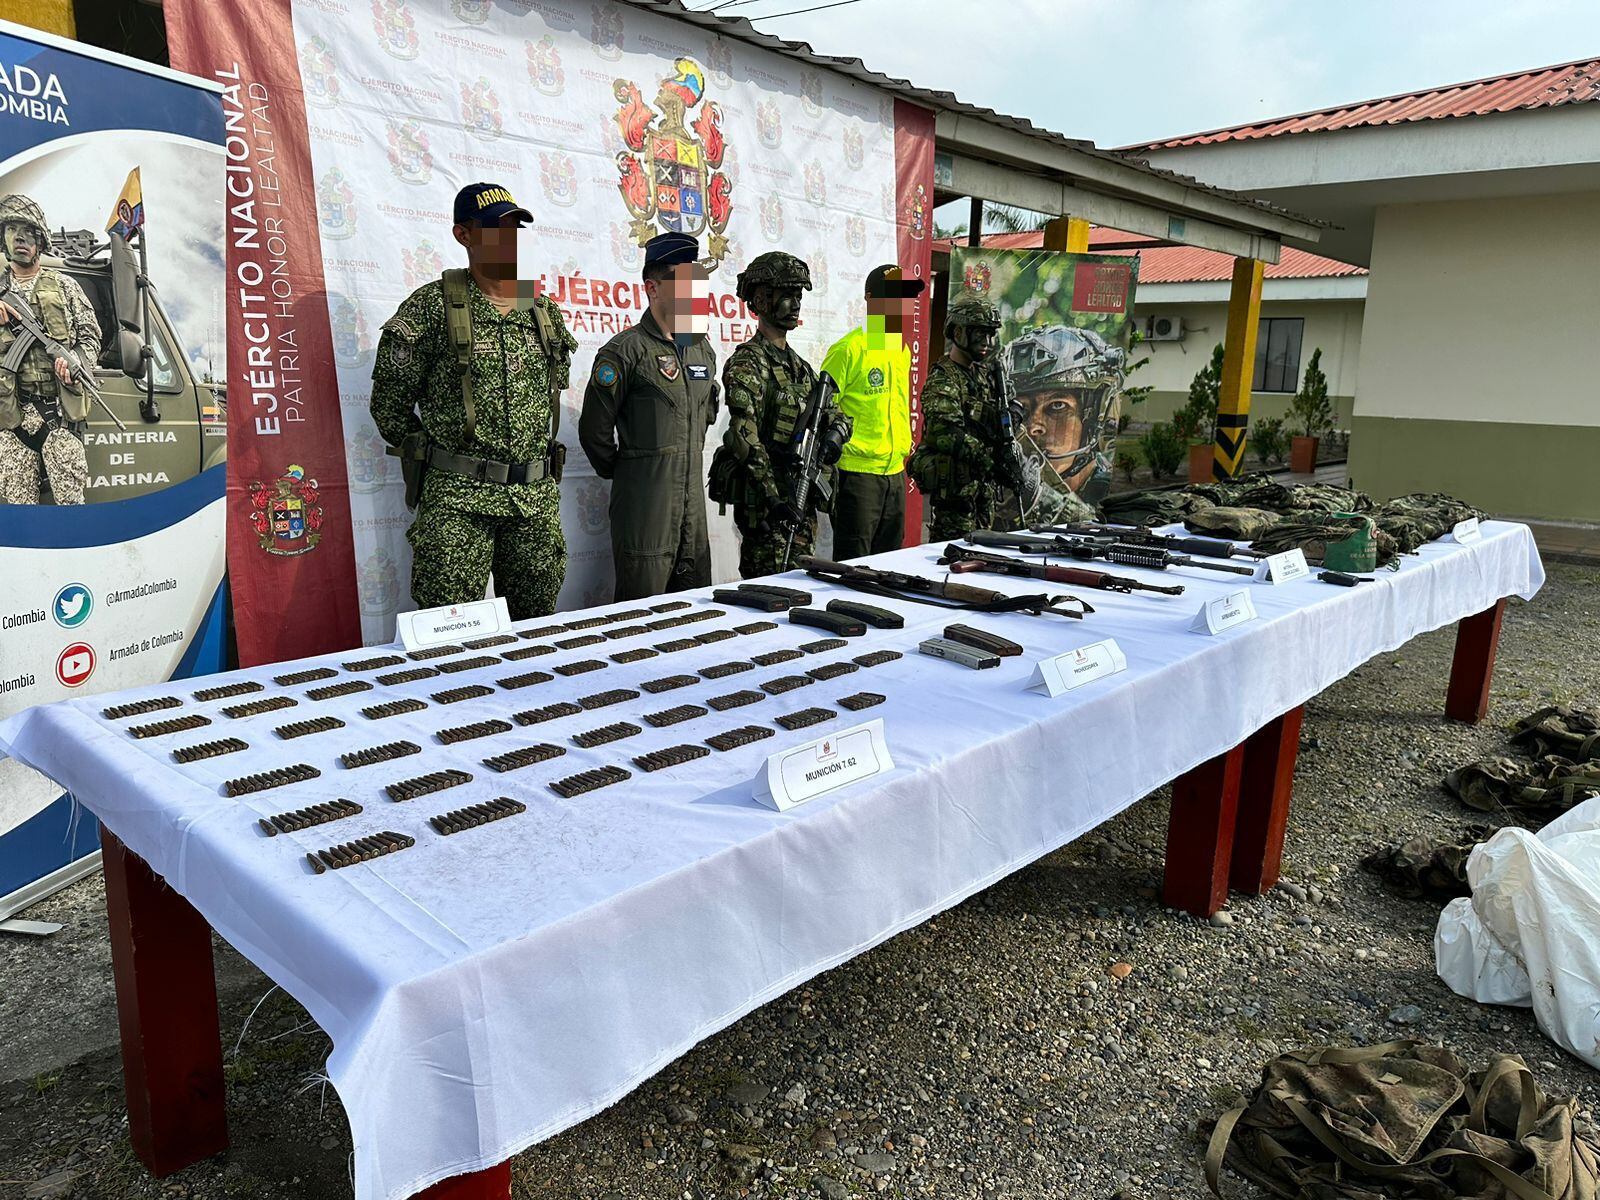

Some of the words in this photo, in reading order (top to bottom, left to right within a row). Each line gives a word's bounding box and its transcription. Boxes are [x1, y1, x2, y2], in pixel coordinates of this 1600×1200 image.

[215, 61, 260, 249] NACIONAL
[248, 82, 281, 207] LEALTAD
[265, 217, 295, 318] HONOR
[236, 261, 281, 435] EJÉRCITO
[277, 328, 306, 422] PATRIA
[84, 431, 177, 445] FANTERIA
[110, 453, 135, 465] DE
[106, 578, 177, 607] @ArmadaColombia
[2, 608, 46, 629] Colombia
[433, 622, 467, 633] MUNICIÓN
[109, 642, 139, 662] Armada
[140, 638, 150, 652] de
[151, 629, 184, 649] Colombia
[805, 762, 842, 782] MUNICIÓN
[841, 757, 857, 769] 7.62
